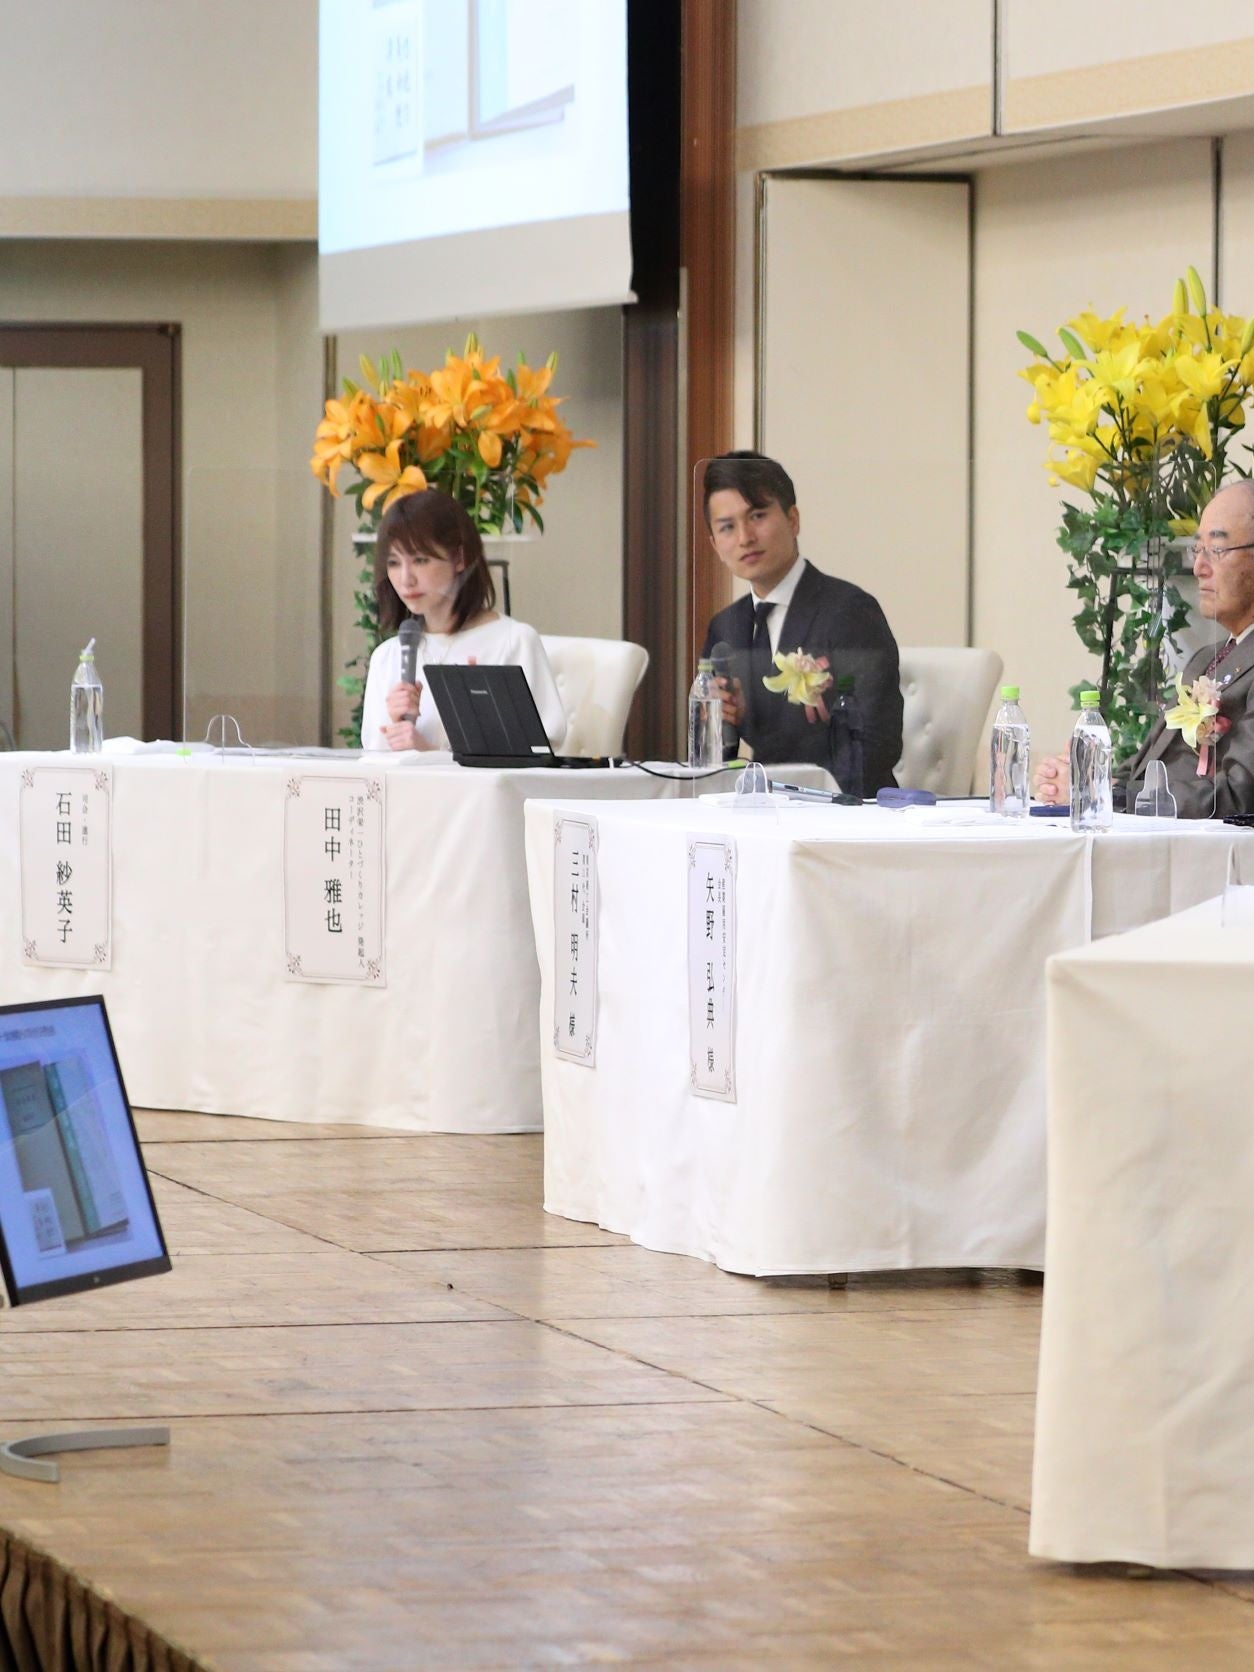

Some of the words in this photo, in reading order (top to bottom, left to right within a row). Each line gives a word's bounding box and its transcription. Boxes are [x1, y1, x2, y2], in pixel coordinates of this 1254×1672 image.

[56, 792, 72, 844] 石田
[324, 808, 341, 862] 田中
[56, 860, 73, 943] 紗英子
[323, 878, 343, 934] 雅也
[571, 851, 579, 913] 三村
[706, 872, 714, 940] 矢野
[570, 933, 578, 996] 明夫
